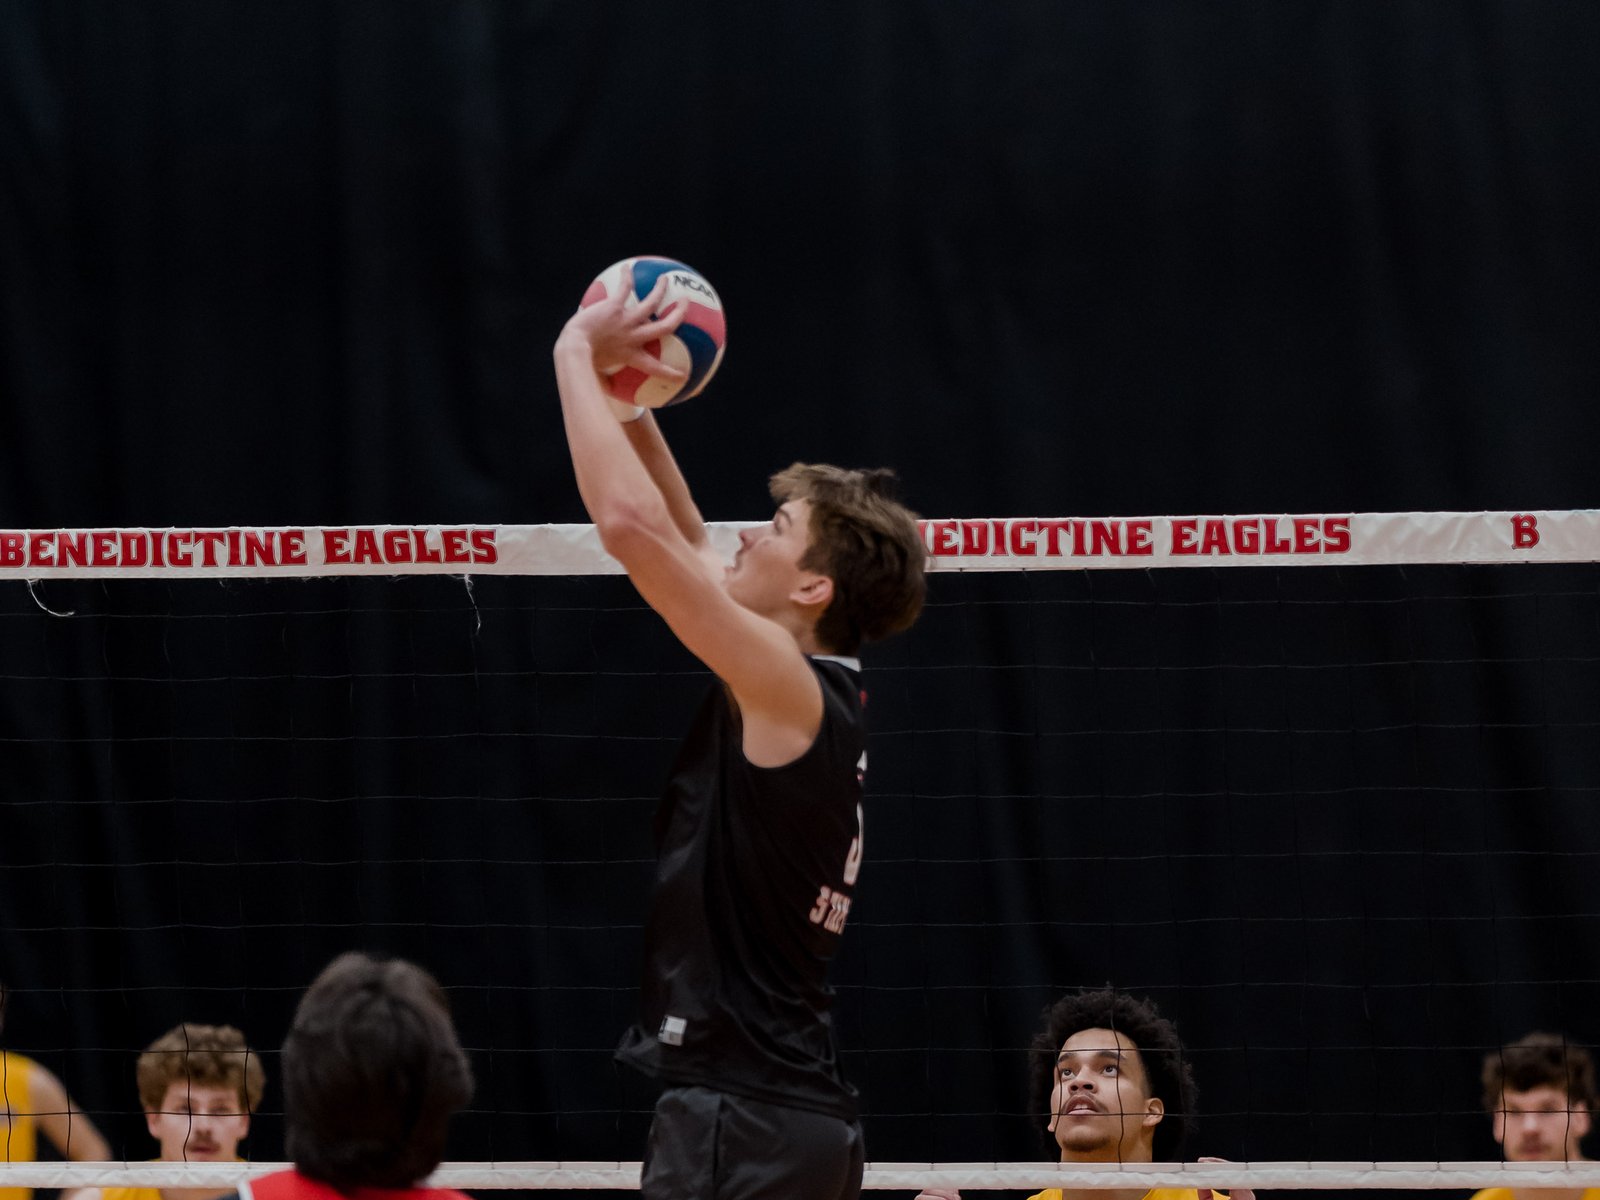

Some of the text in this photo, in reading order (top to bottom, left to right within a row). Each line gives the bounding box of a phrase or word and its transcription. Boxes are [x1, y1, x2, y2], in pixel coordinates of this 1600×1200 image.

[674, 275, 715, 302] NCAA
[0, 528, 499, 568] BENEDICTINE EAGLES
[1170, 518, 1352, 556] EAGLES
[1510, 513, 1541, 550] B
